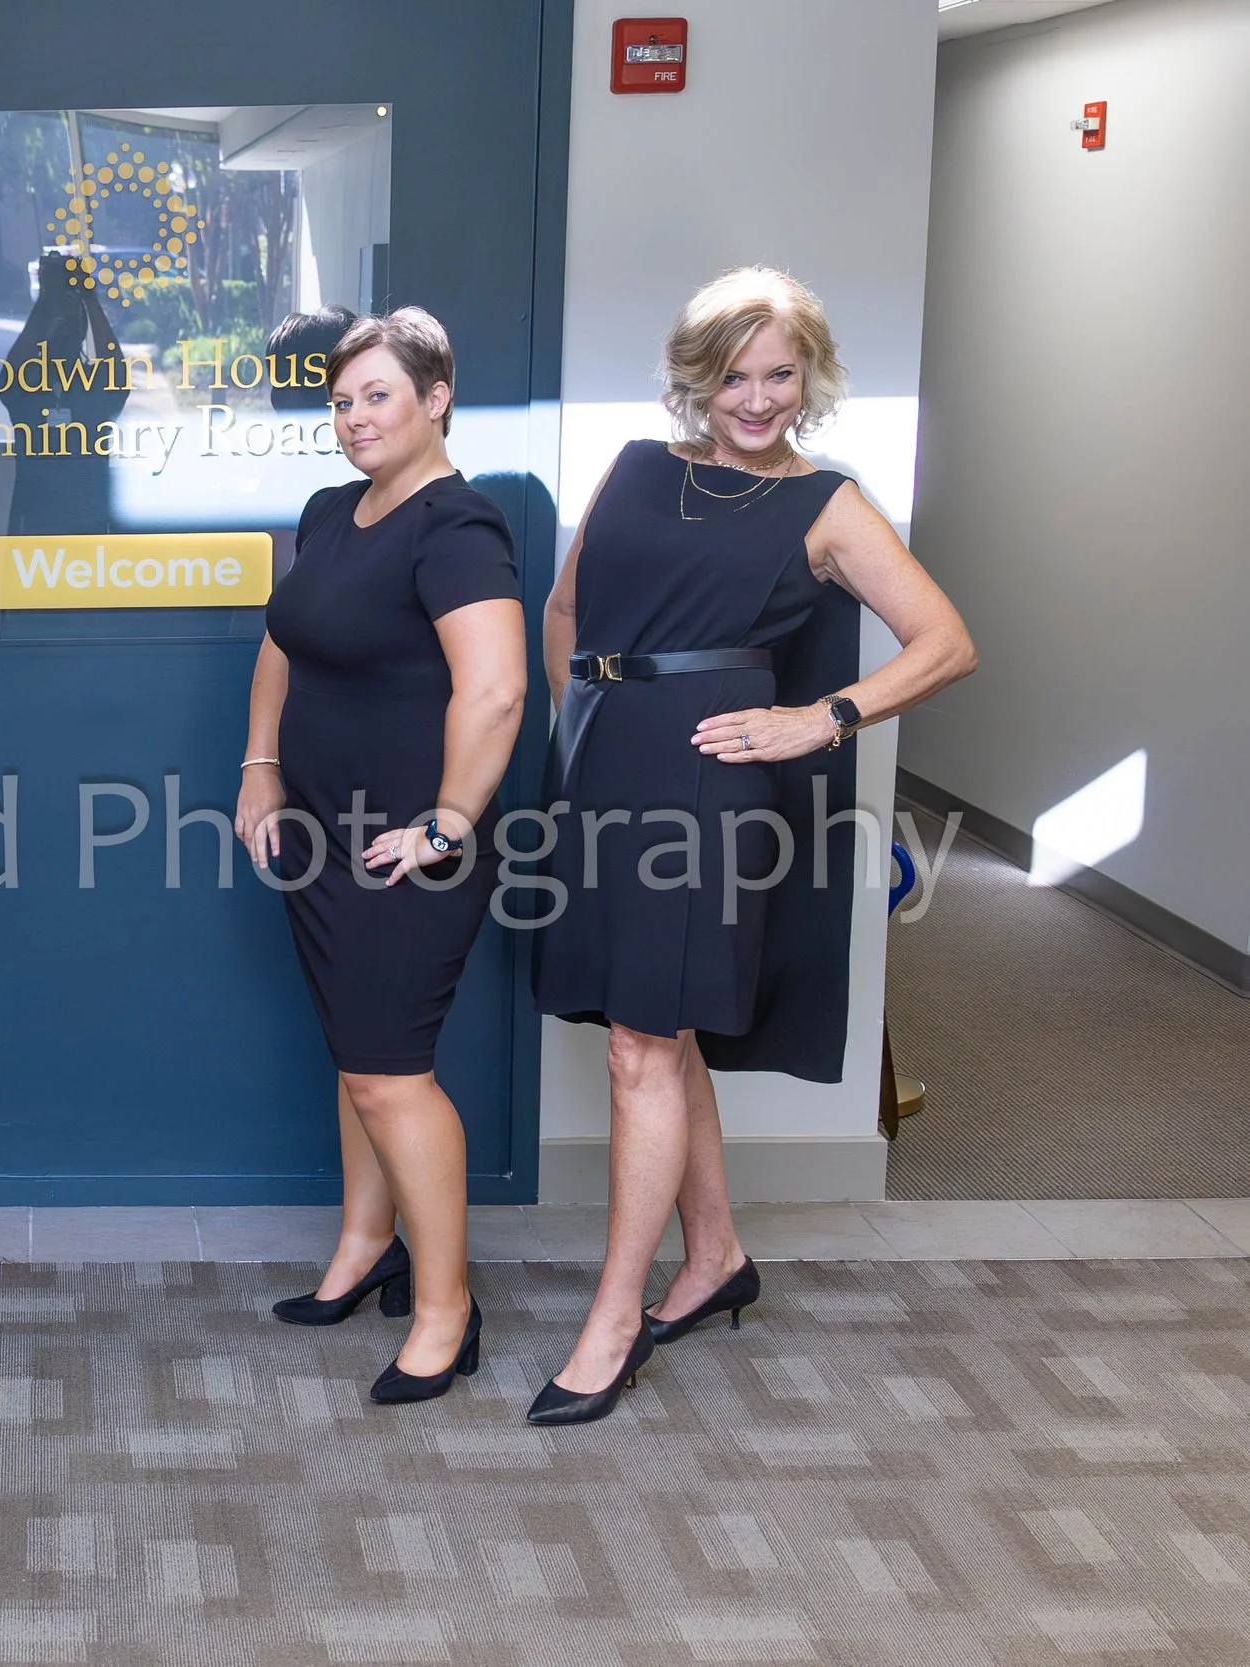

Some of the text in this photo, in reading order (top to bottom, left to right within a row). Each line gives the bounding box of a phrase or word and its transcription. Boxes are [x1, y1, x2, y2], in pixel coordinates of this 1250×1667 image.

[654, 71, 677, 81] FIRE
[176, 338, 328, 390] Hous
[196, 401, 346, 457] Road
[12, 545, 242, 588] Welcome
